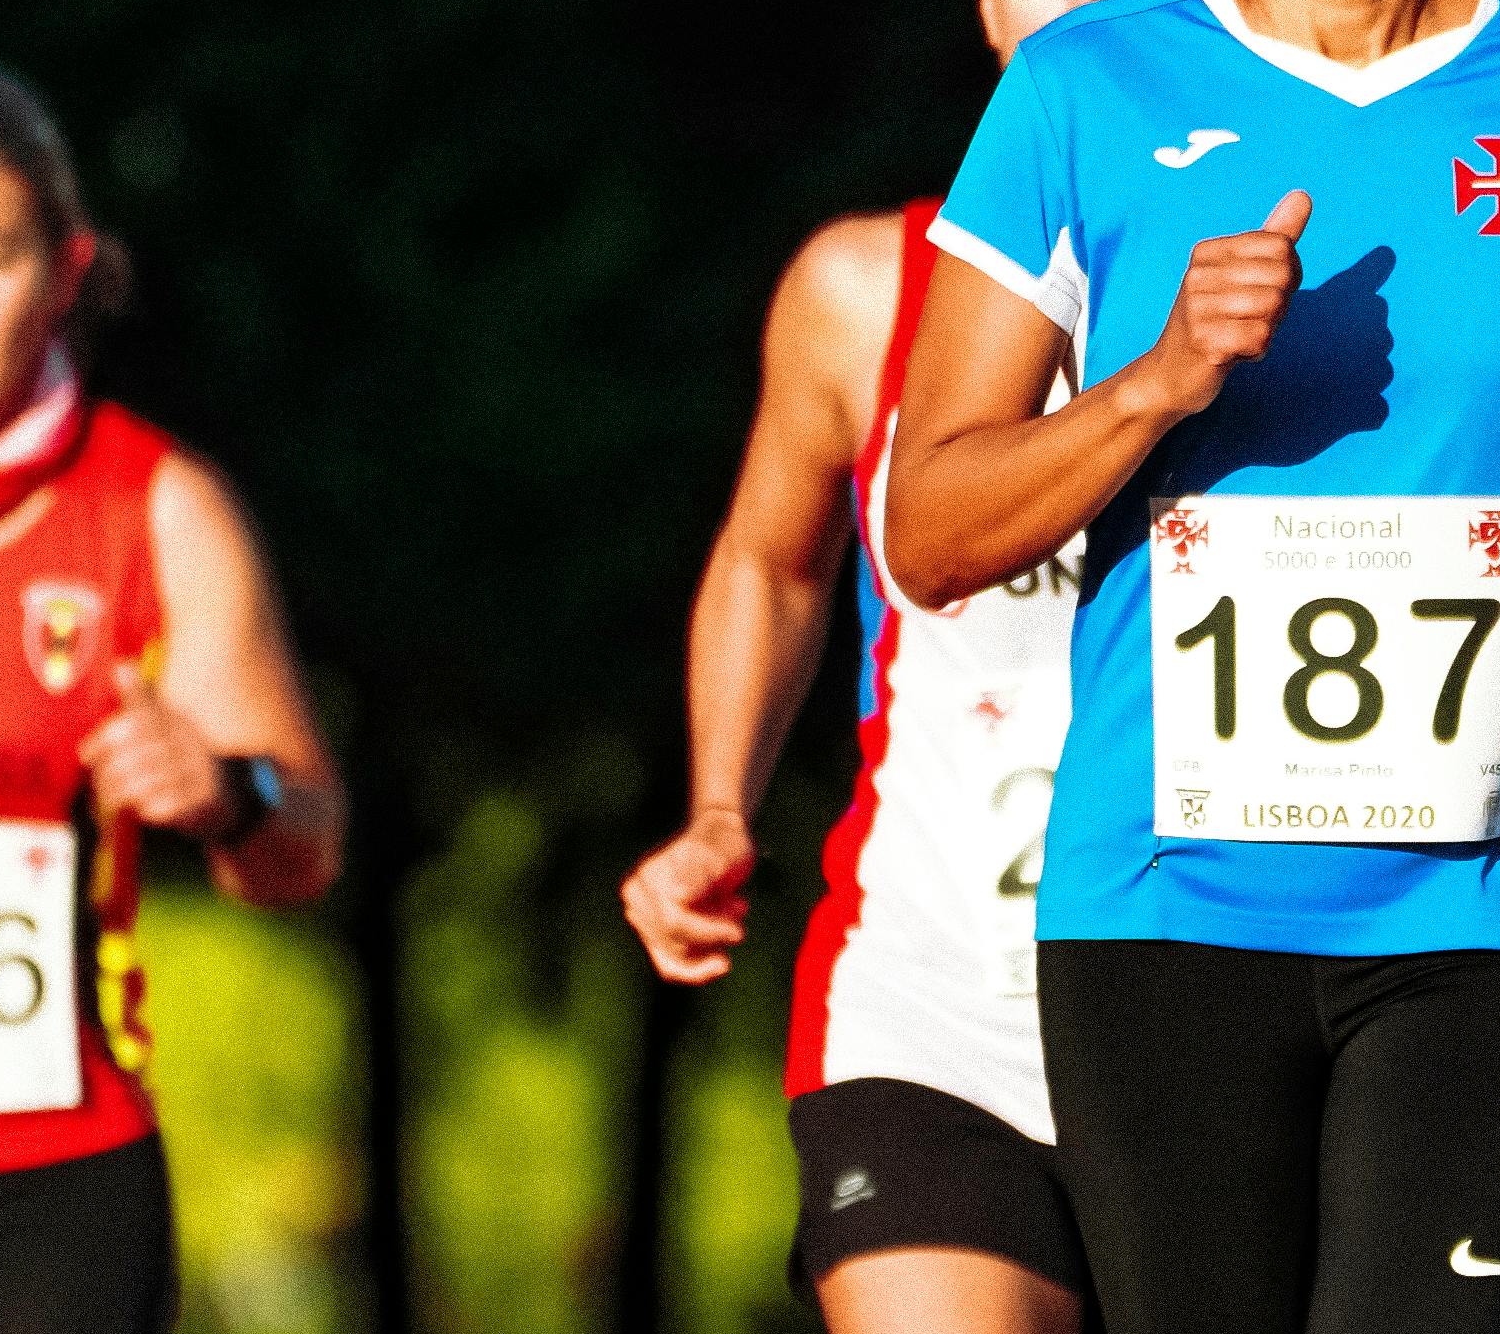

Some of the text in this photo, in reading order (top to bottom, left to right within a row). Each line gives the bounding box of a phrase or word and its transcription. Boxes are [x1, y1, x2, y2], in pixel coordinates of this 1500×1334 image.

[1273, 513, 1402, 541] Nacional
[1263, 550, 1318, 570] 5000
[1346, 550, 1412, 570] 10000
[1242, 803, 1437, 831] LISBOA 2020
